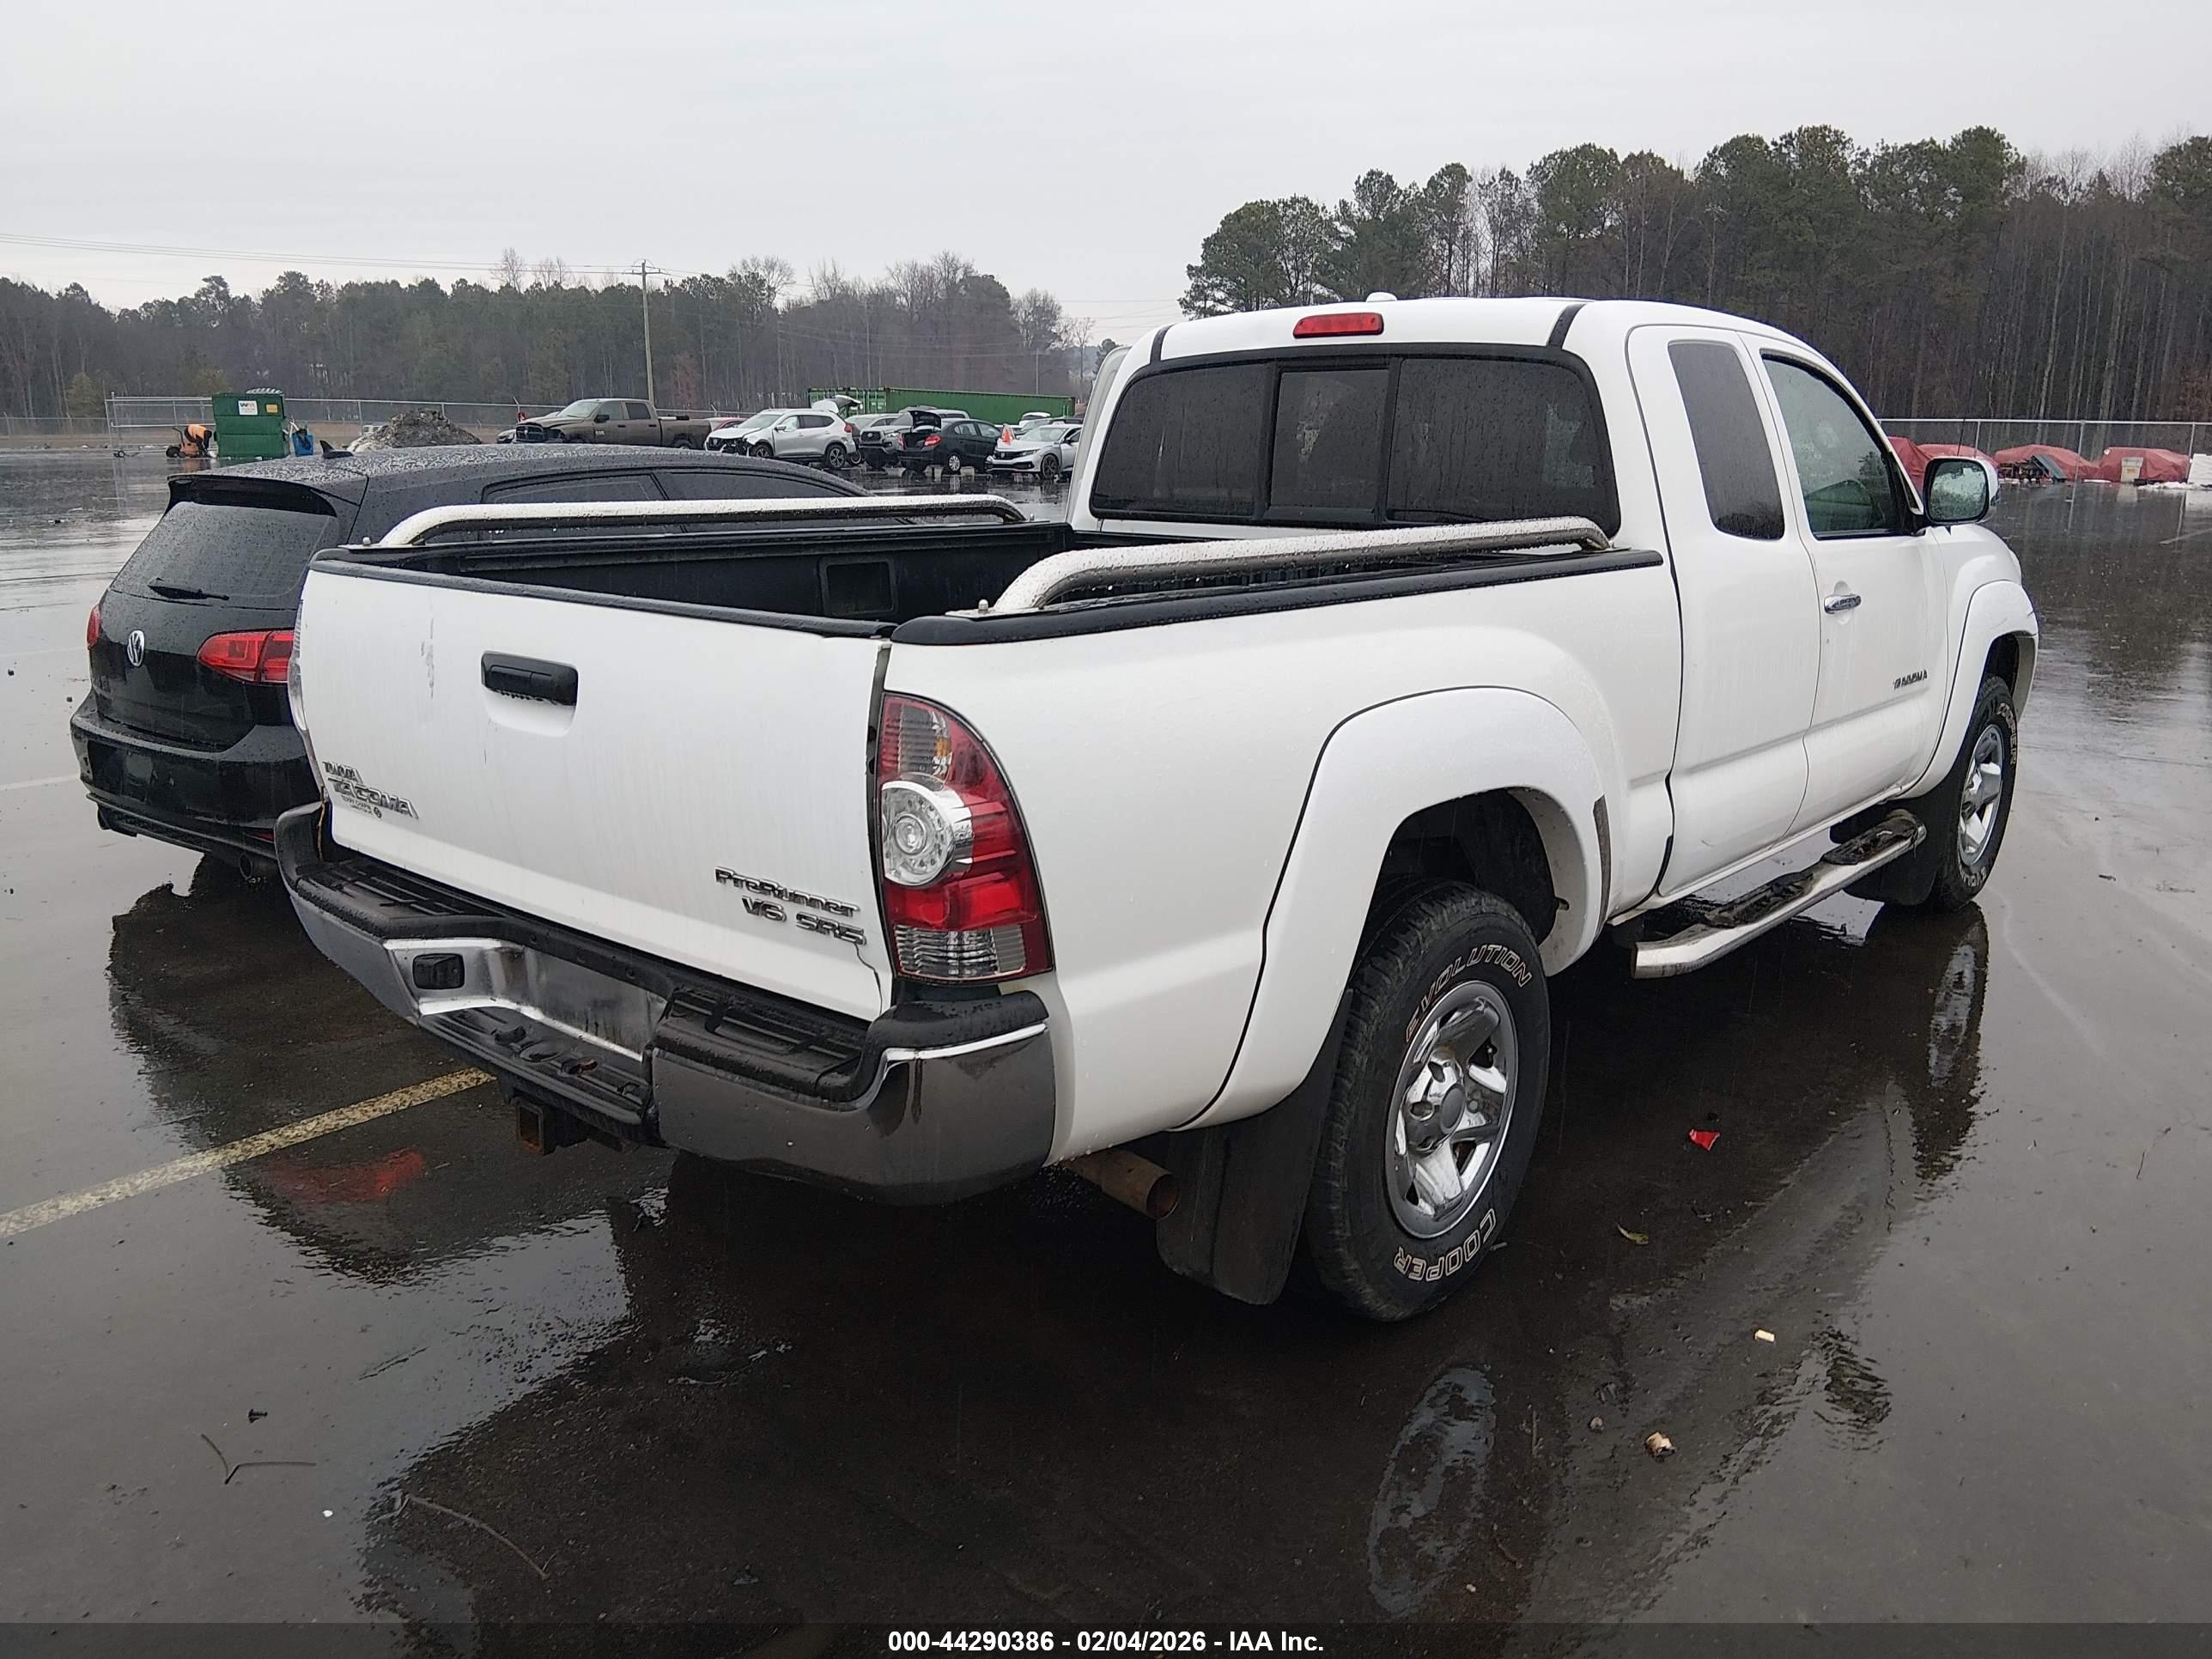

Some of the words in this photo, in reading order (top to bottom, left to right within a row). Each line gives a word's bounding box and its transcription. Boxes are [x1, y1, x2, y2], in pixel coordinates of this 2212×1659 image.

[327, 775, 420, 819] TACOMA
[741, 895, 787, 922] V6
[795, 911, 868, 945] SR5
[1405, 945, 1533, 1045] EVOLUTION
[1392, 1207, 1497, 1282] COOPER
